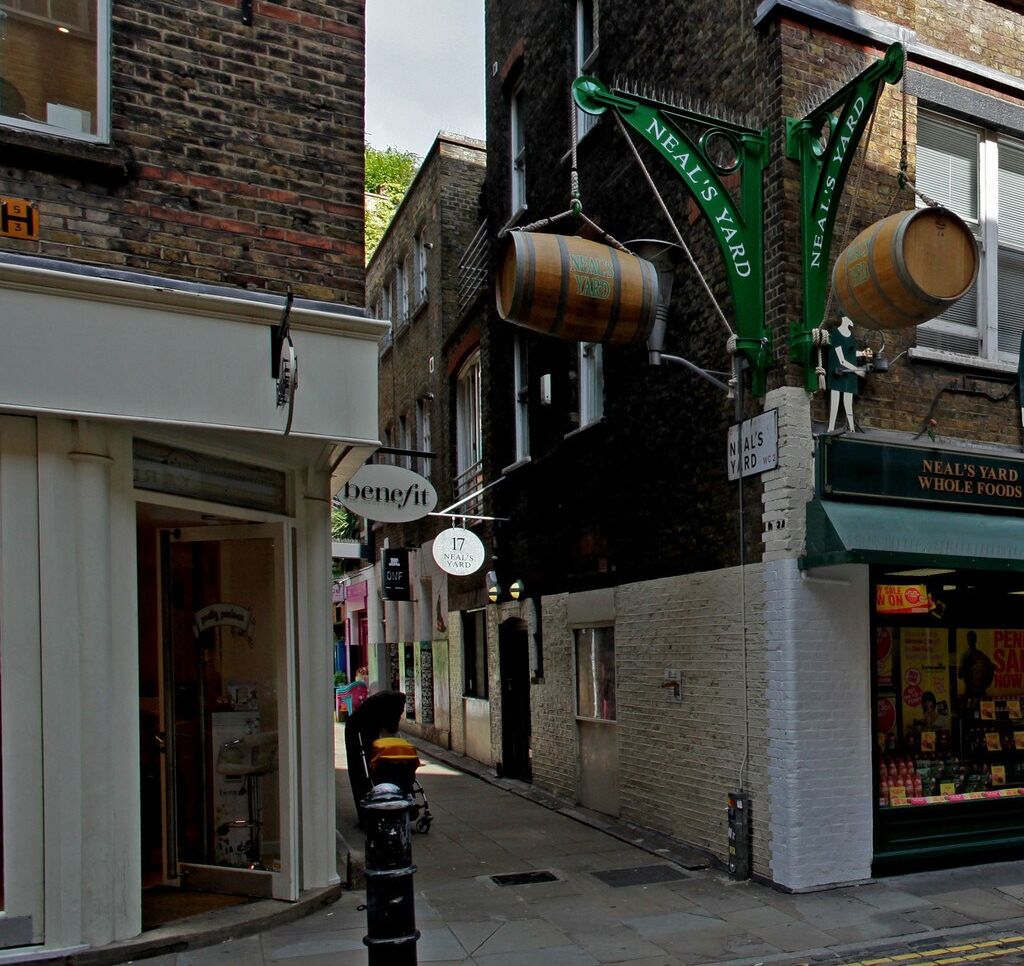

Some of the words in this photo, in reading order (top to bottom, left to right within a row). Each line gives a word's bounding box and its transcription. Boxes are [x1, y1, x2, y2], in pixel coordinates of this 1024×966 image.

[811, 175, 836, 268] NEAL'S
[832, 96, 865, 163] YARD
[645, 117, 719, 202] NEAL'S
[715, 207, 751, 277] YARD
[570, 253, 615, 279] NEAL'S
[575, 275, 611, 300] YARD
[730, 431, 764, 457] NAL'S
[922, 459, 976, 478] NEAL'S
[979, 465, 1019, 482] YARD
[343, 481, 431, 509] benefit
[918, 475, 974, 494] WHOLE
[977, 481, 1023, 499] FOODS
[452, 537, 466, 551] 17
[444, 553, 474, 562] NEAL'S
[447, 561, 471, 569] YARD
[884, 586, 902, 595] SALE
[888, 594, 904, 606] ON
[994, 672, 1023, 690] NOW
